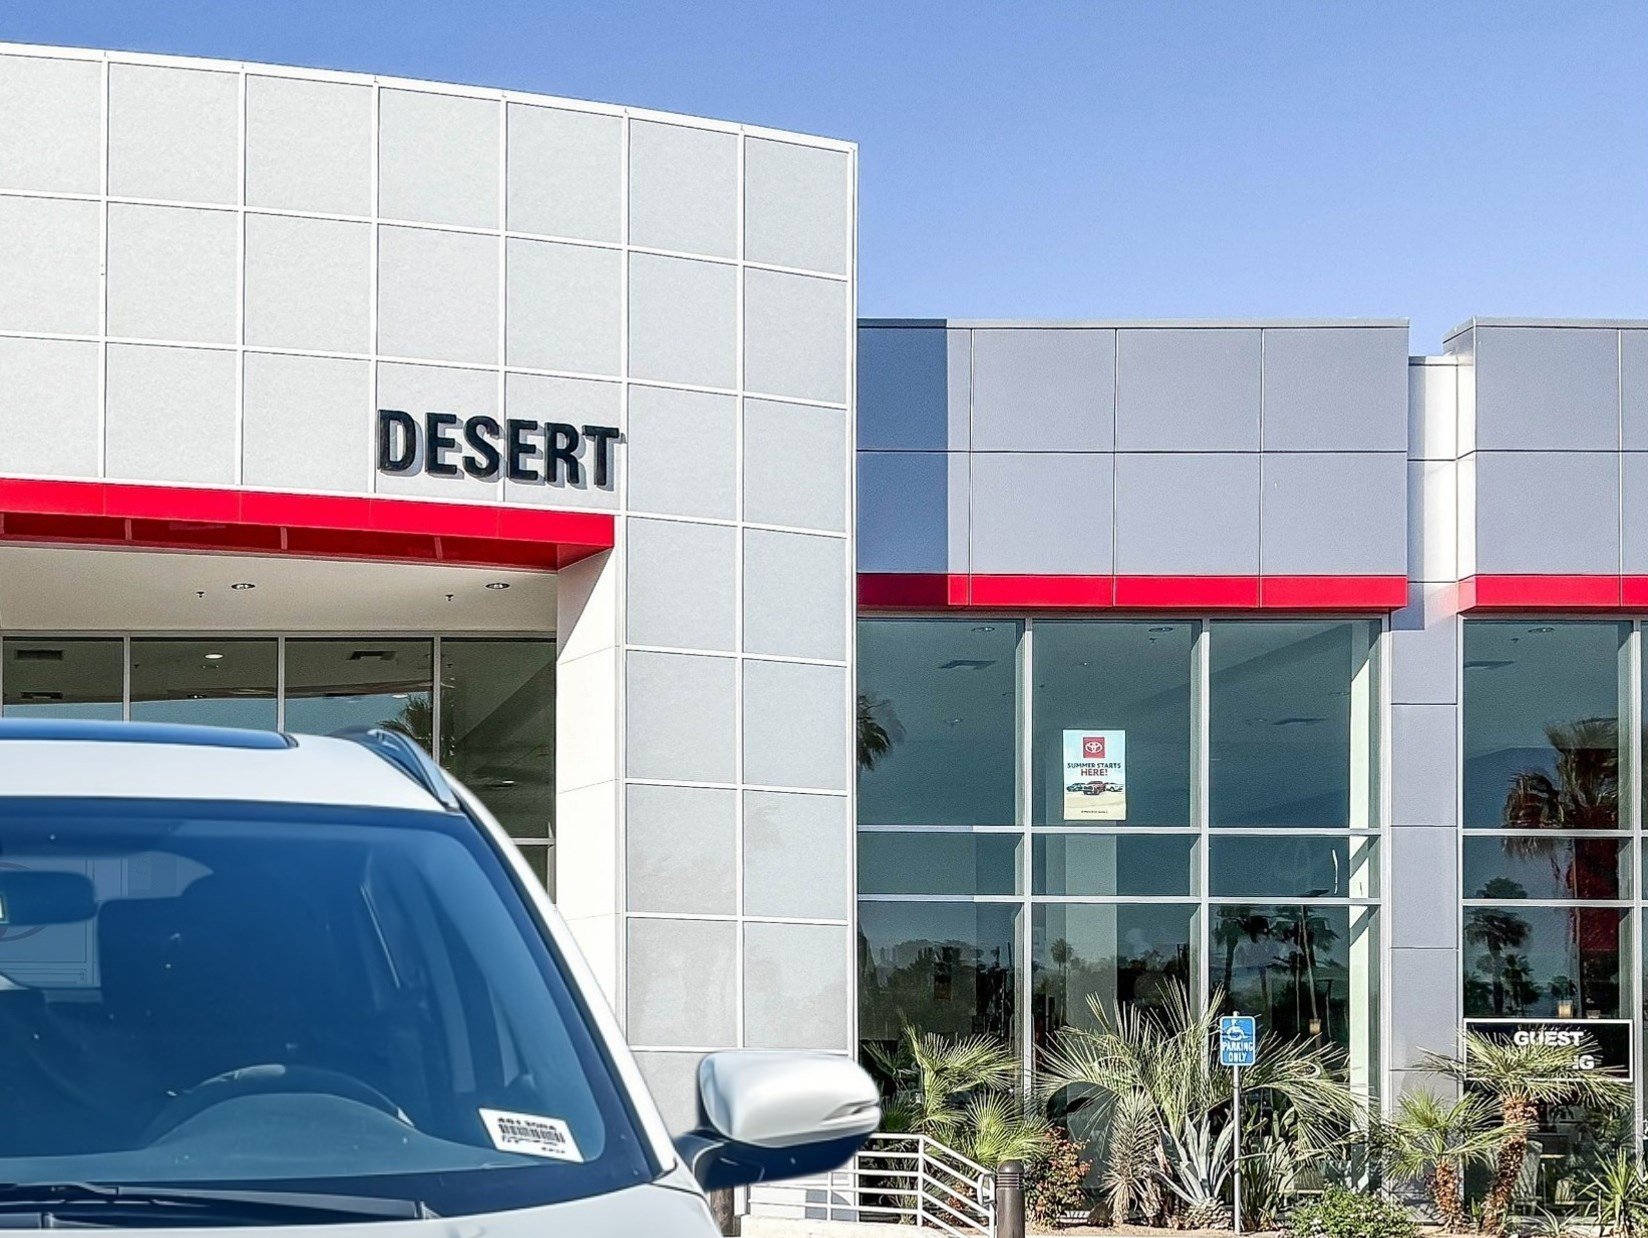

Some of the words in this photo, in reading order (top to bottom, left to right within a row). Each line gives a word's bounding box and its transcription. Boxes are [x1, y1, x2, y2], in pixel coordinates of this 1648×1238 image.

[377, 409, 620, 487] DESERT
[1513, 1031, 1584, 1046] GUEST
[1222, 1041, 1253, 1051] PARKING
[1228, 1052, 1247, 1062] ONLY
